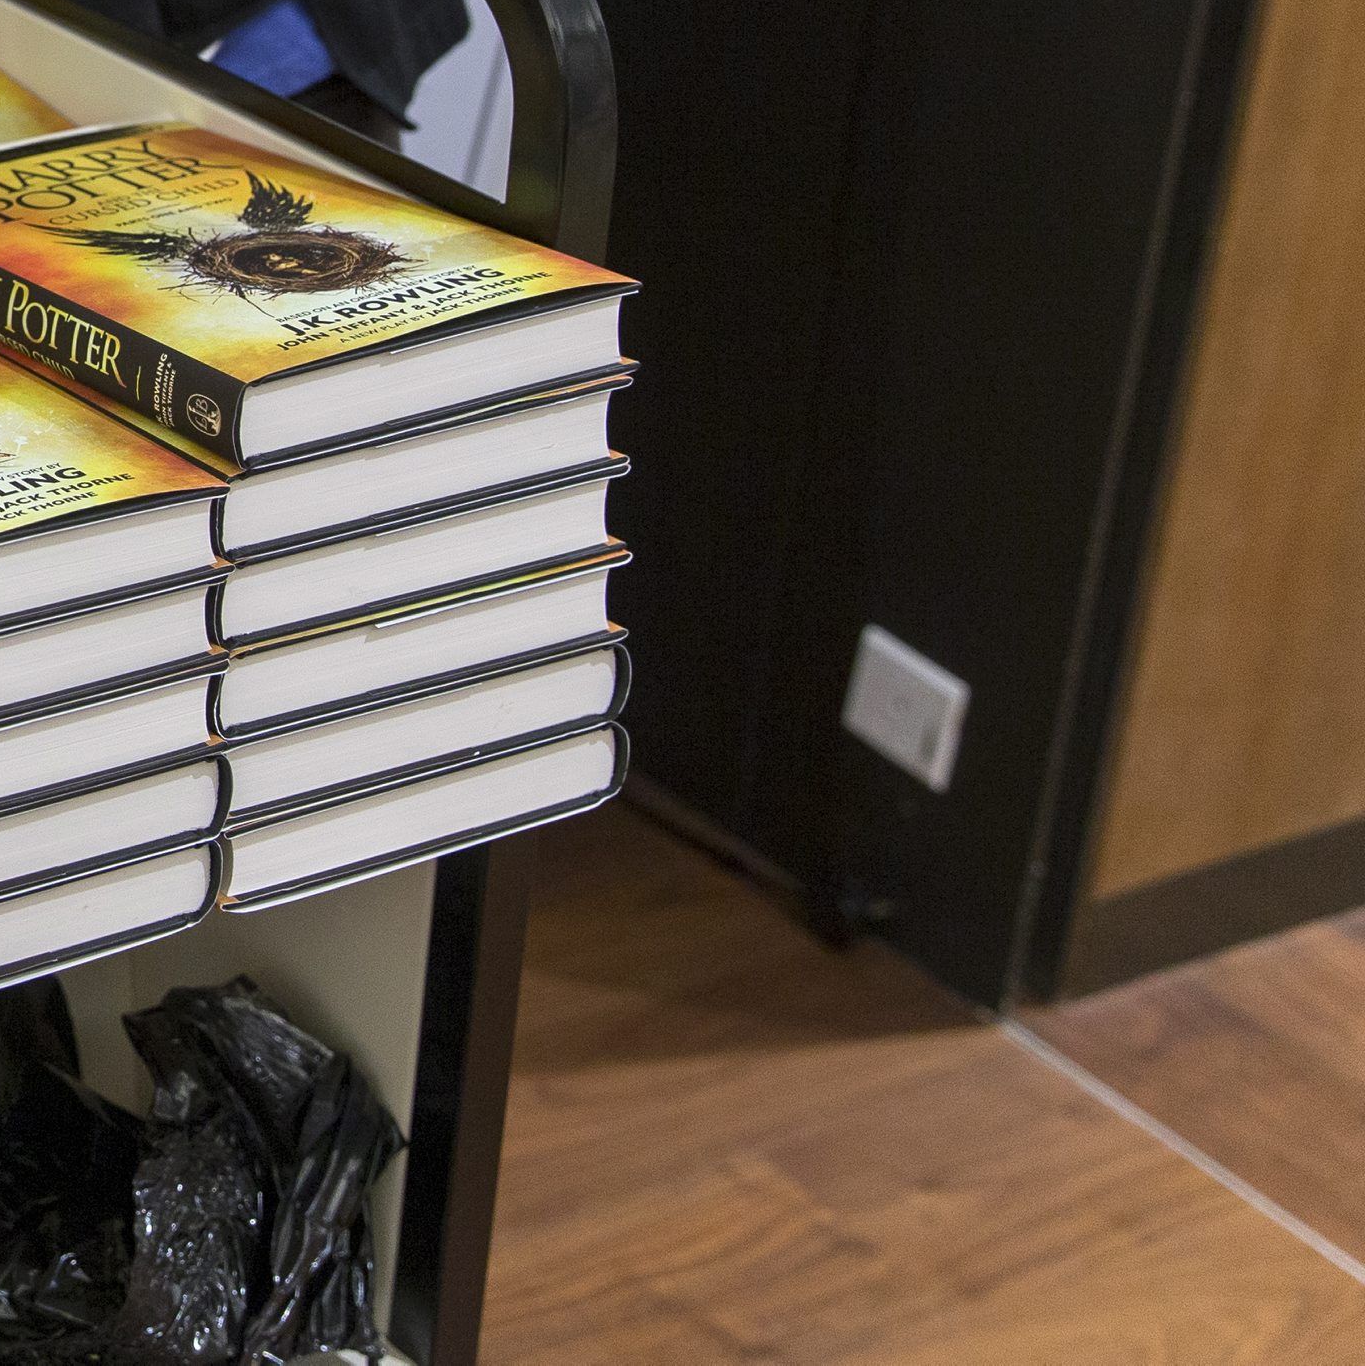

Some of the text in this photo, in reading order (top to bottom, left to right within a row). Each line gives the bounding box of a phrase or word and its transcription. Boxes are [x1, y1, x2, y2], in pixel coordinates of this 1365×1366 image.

[49, 199, 152, 225] CURSED
[276, 312, 311, 323] BASED
[312, 305, 331, 315] ON
[332, 300, 350, 309] AN
[351, 288, 400, 304] ORIGINAL
[428, 269, 462, 281] STORY
[276, 271, 553, 351] JOHN TIFFANY & JACK THORNE
[280, 268, 505, 336] J.K. ROWLING
[381, 320, 410, 333] PLAY
[428, 303, 462, 317] JACK
[461, 287, 525, 305] THORNE
[5, 280, 127, 389] POTTER
[154, 353, 168, 412] ROWLING
[159, 369, 171, 407] TIFFANY
[168, 369, 176, 404] THORNE
[7, 467, 45, 481] STORY
[46, 462, 61, 471] BY
[49, 473, 135, 496] THORNE
[29, 491, 98, 510] THORNE
